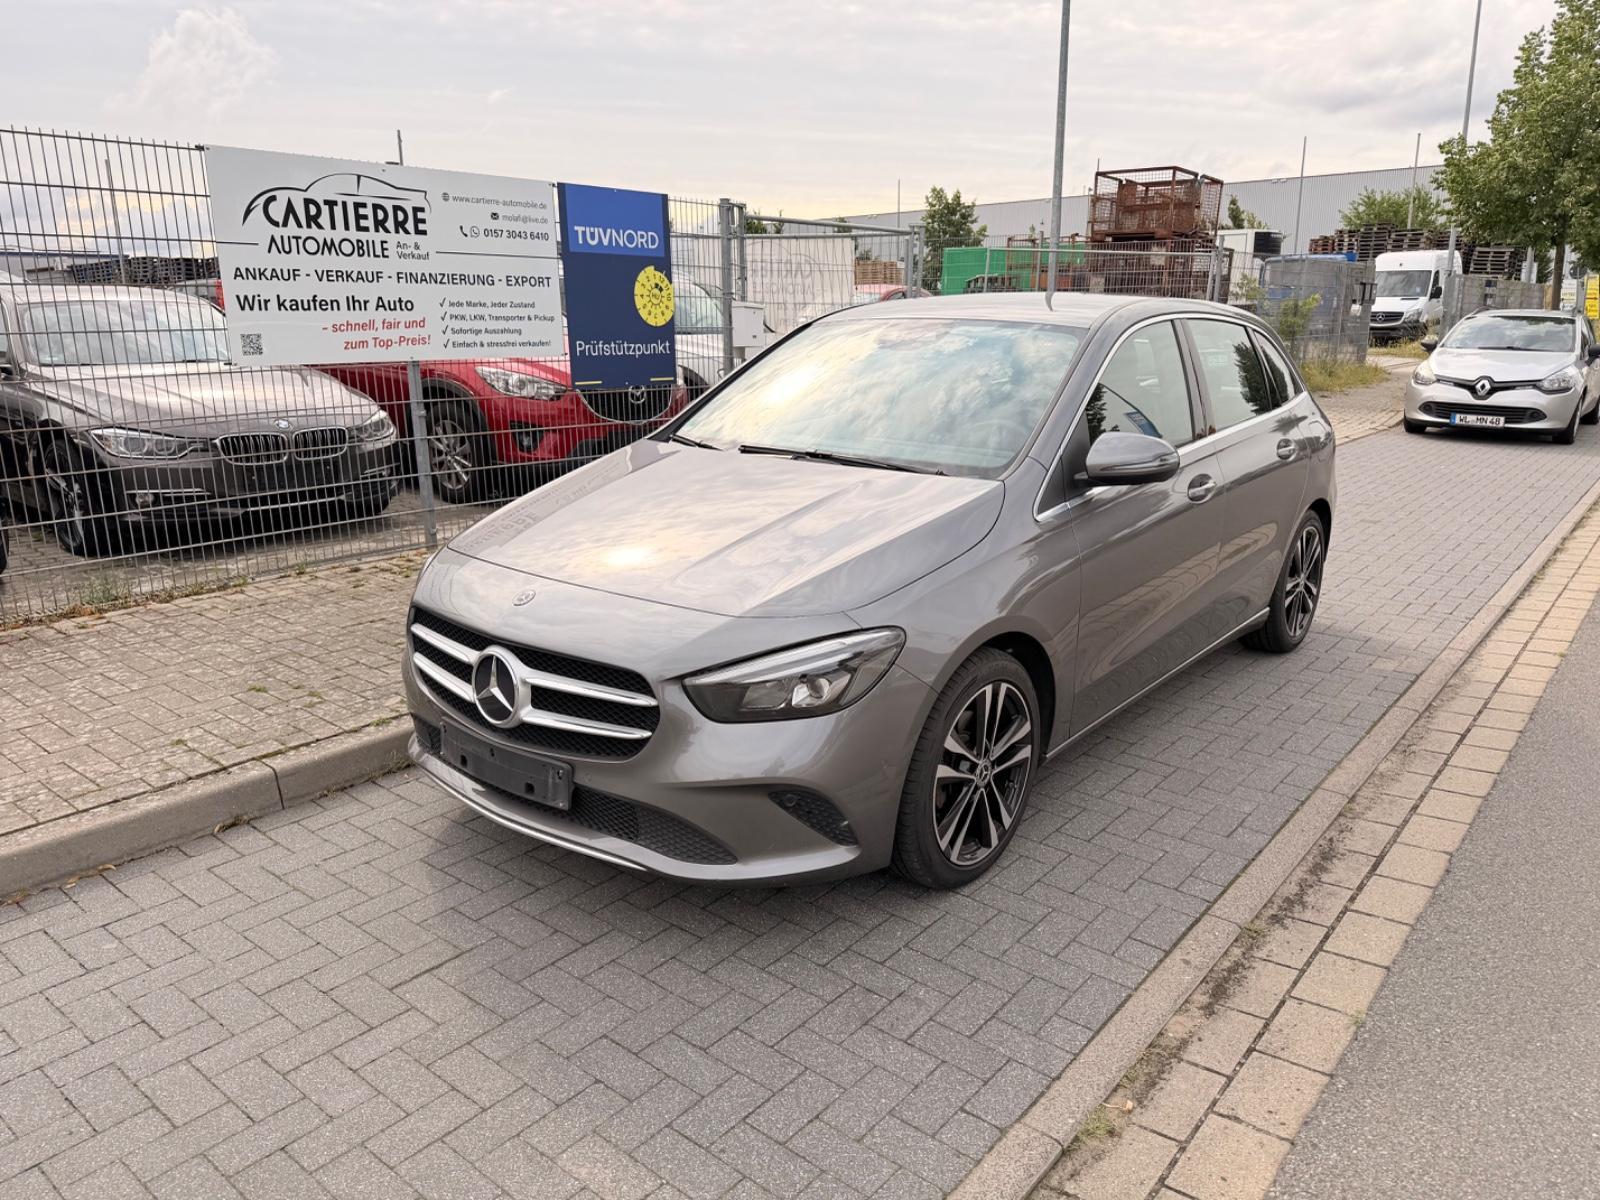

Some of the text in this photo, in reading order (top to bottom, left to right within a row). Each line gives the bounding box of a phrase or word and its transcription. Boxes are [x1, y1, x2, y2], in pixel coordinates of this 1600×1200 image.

[452, 195, 547, 209] www.cartierre-automobile.de
[263, 195, 428, 235] CARTIERRE
[484, 228, 549, 241] 0157 3043 6410
[267, 234, 389, 259] AUTOMOBILE
[396, 241, 411, 250] An-
[397, 251, 430, 261] Verkauf
[233, 267, 301, 281] ANKAUF
[314, 269, 383, 283] VERKAUF
[397, 271, 495, 287] FINANZIERUNG
[505, 274, 552, 288] EXPORT
[235, 294, 415, 312] Wir kaufen Ihr Auto
[509, 301, 535, 309] Zustand
[331, 319, 379, 333] schnell,
[382, 318, 401, 330] fair
[404, 317, 426, 330] und
[488, 314, 525, 322] Transporter
[534, 314, 555, 323] Pickup
[451, 327, 522, 336] Sofortige Auszahlung
[343, 334, 431, 350] zum Top-Preis!
[486, 340, 517, 348] stressfrei
[576, 339, 671, 358] Prüfstützpunkt
[1489, 417, 1501, 425] 48
